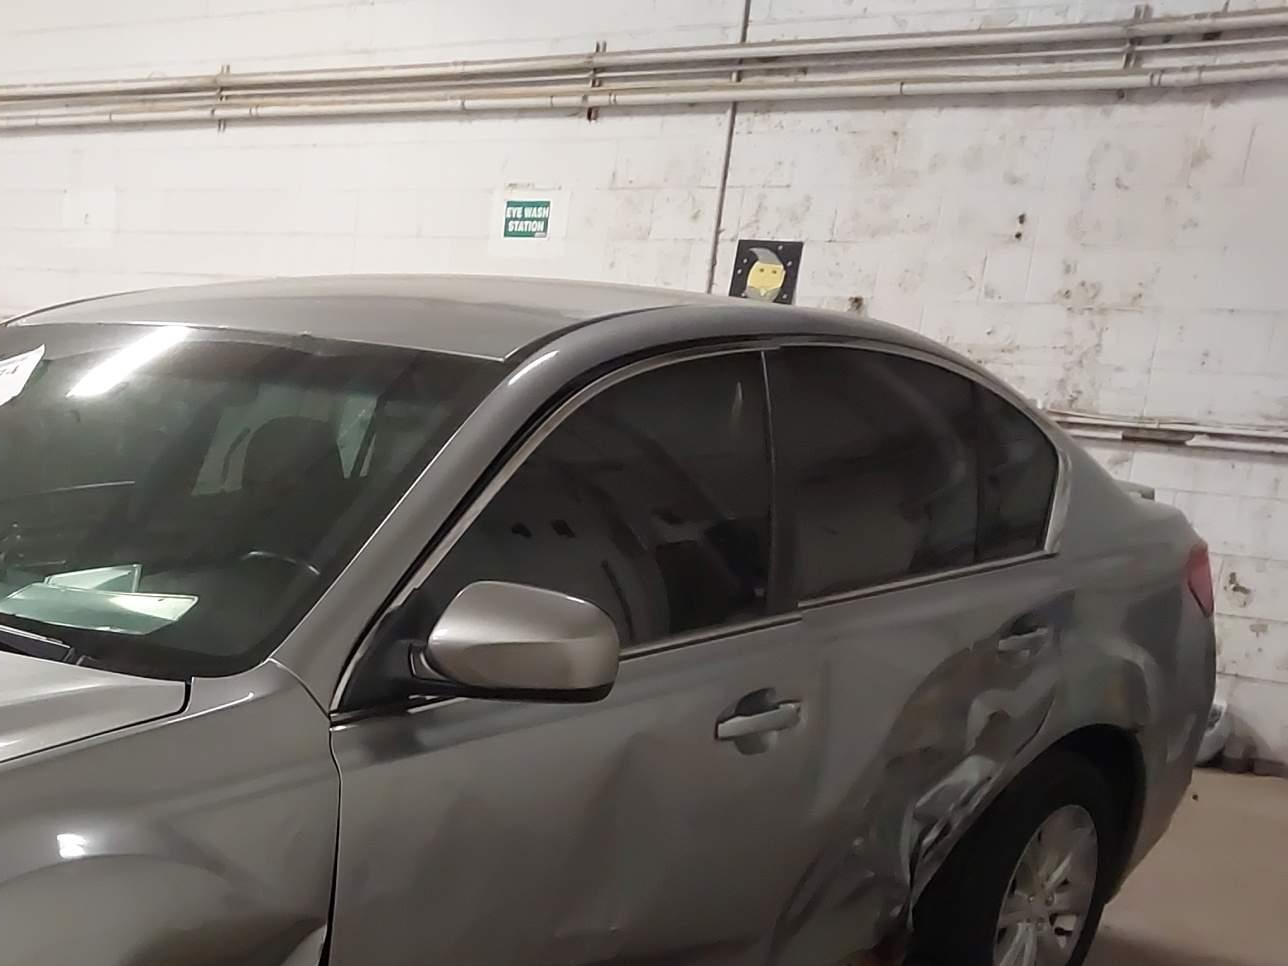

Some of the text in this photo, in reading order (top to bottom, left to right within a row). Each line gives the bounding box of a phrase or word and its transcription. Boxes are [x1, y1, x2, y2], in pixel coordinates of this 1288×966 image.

[505, 207, 549, 218] EYE WASH
[508, 220, 545, 232] STATION
